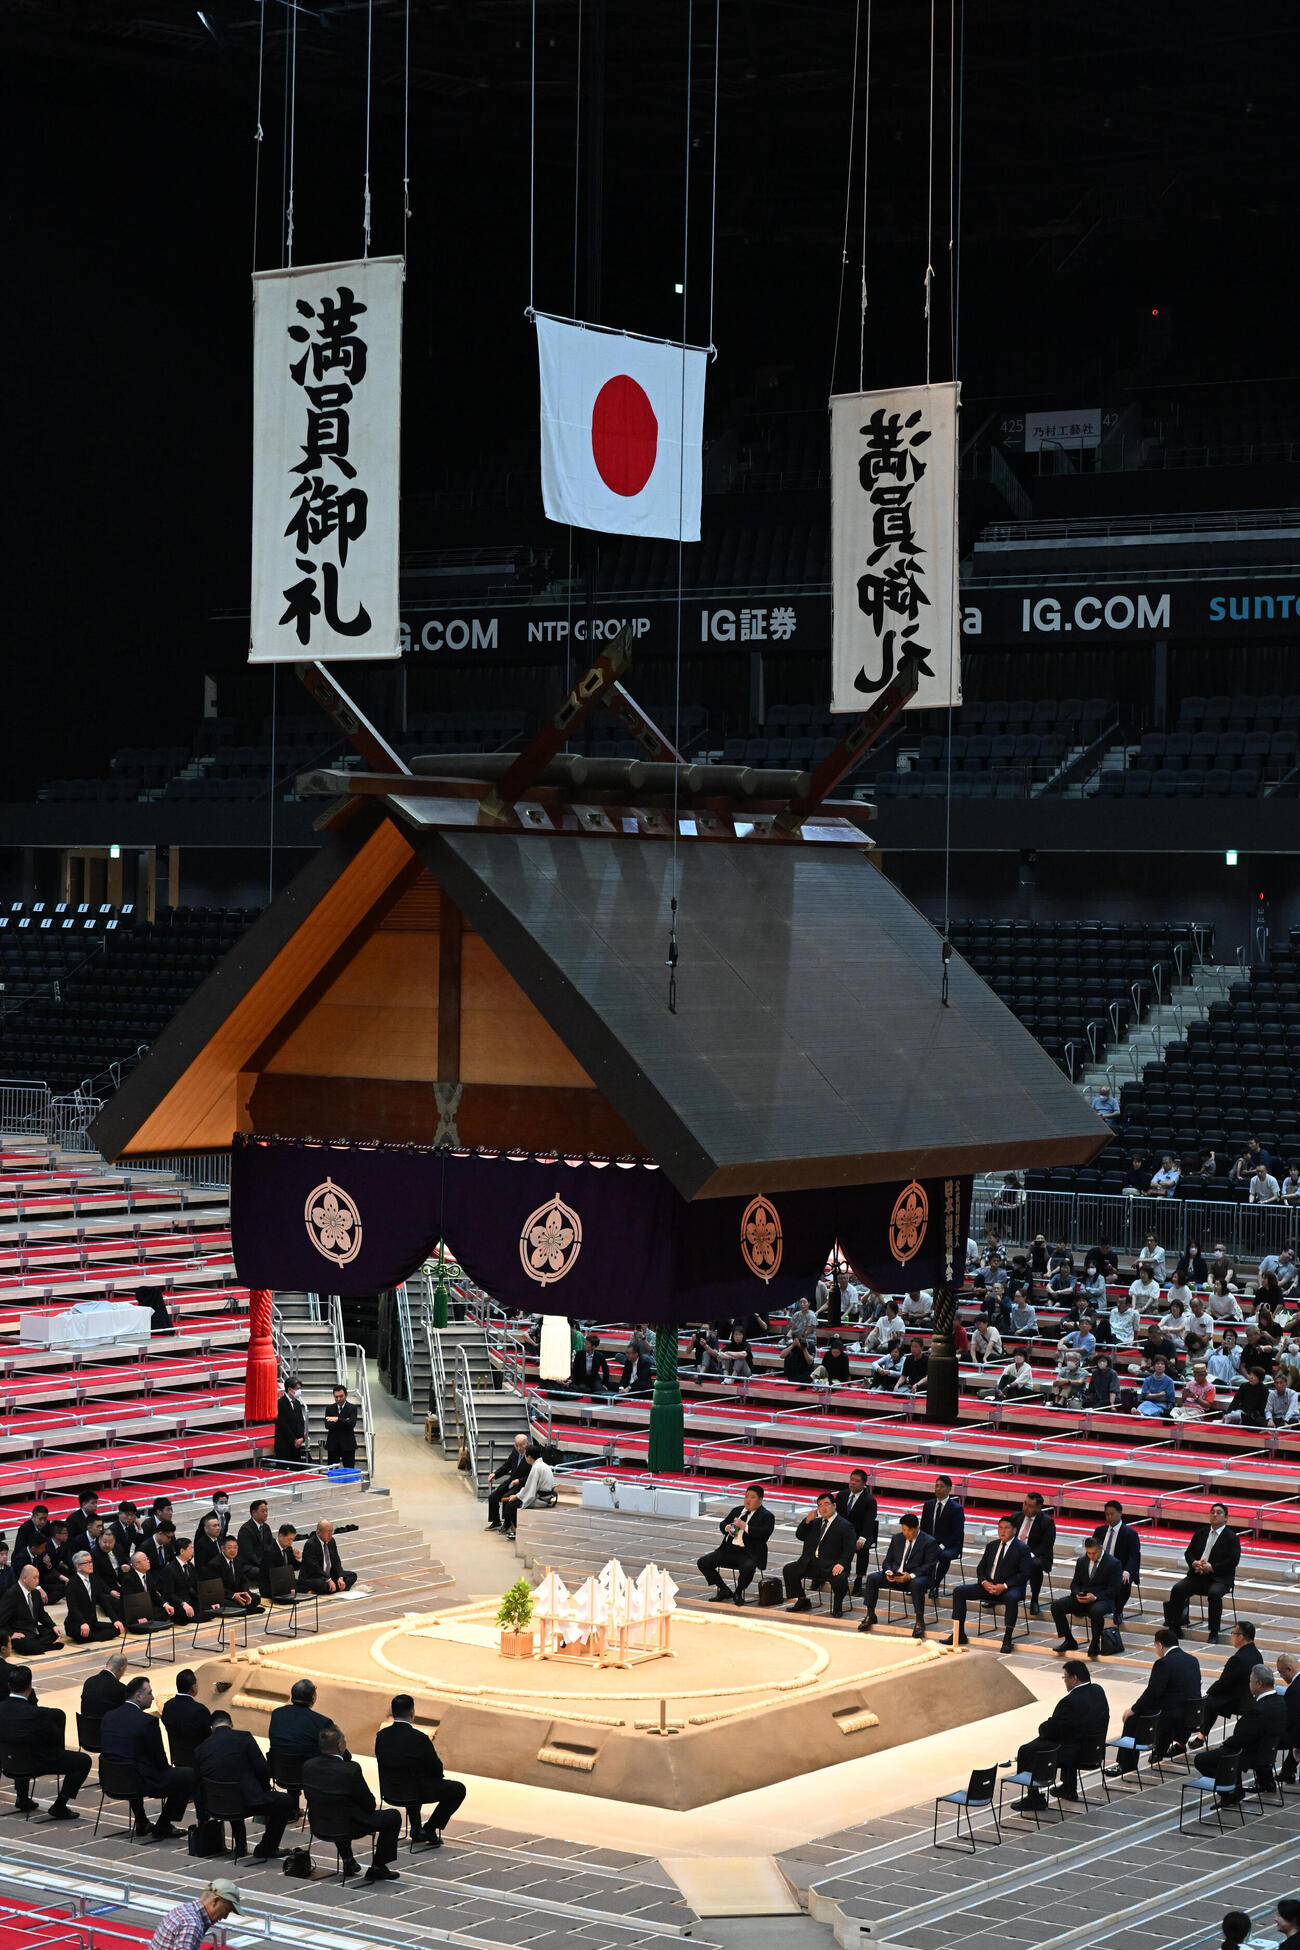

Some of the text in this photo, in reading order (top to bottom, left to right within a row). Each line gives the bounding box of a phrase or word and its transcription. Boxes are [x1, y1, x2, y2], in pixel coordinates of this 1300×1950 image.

[999, 419, 1024, 433] 425
[279, 286, 373, 646] 満員御礼
[701, 606, 797, 642] IG証券
[1022, 593, 1171, 633] IG.COM
[527, 621, 569, 643] NTP
